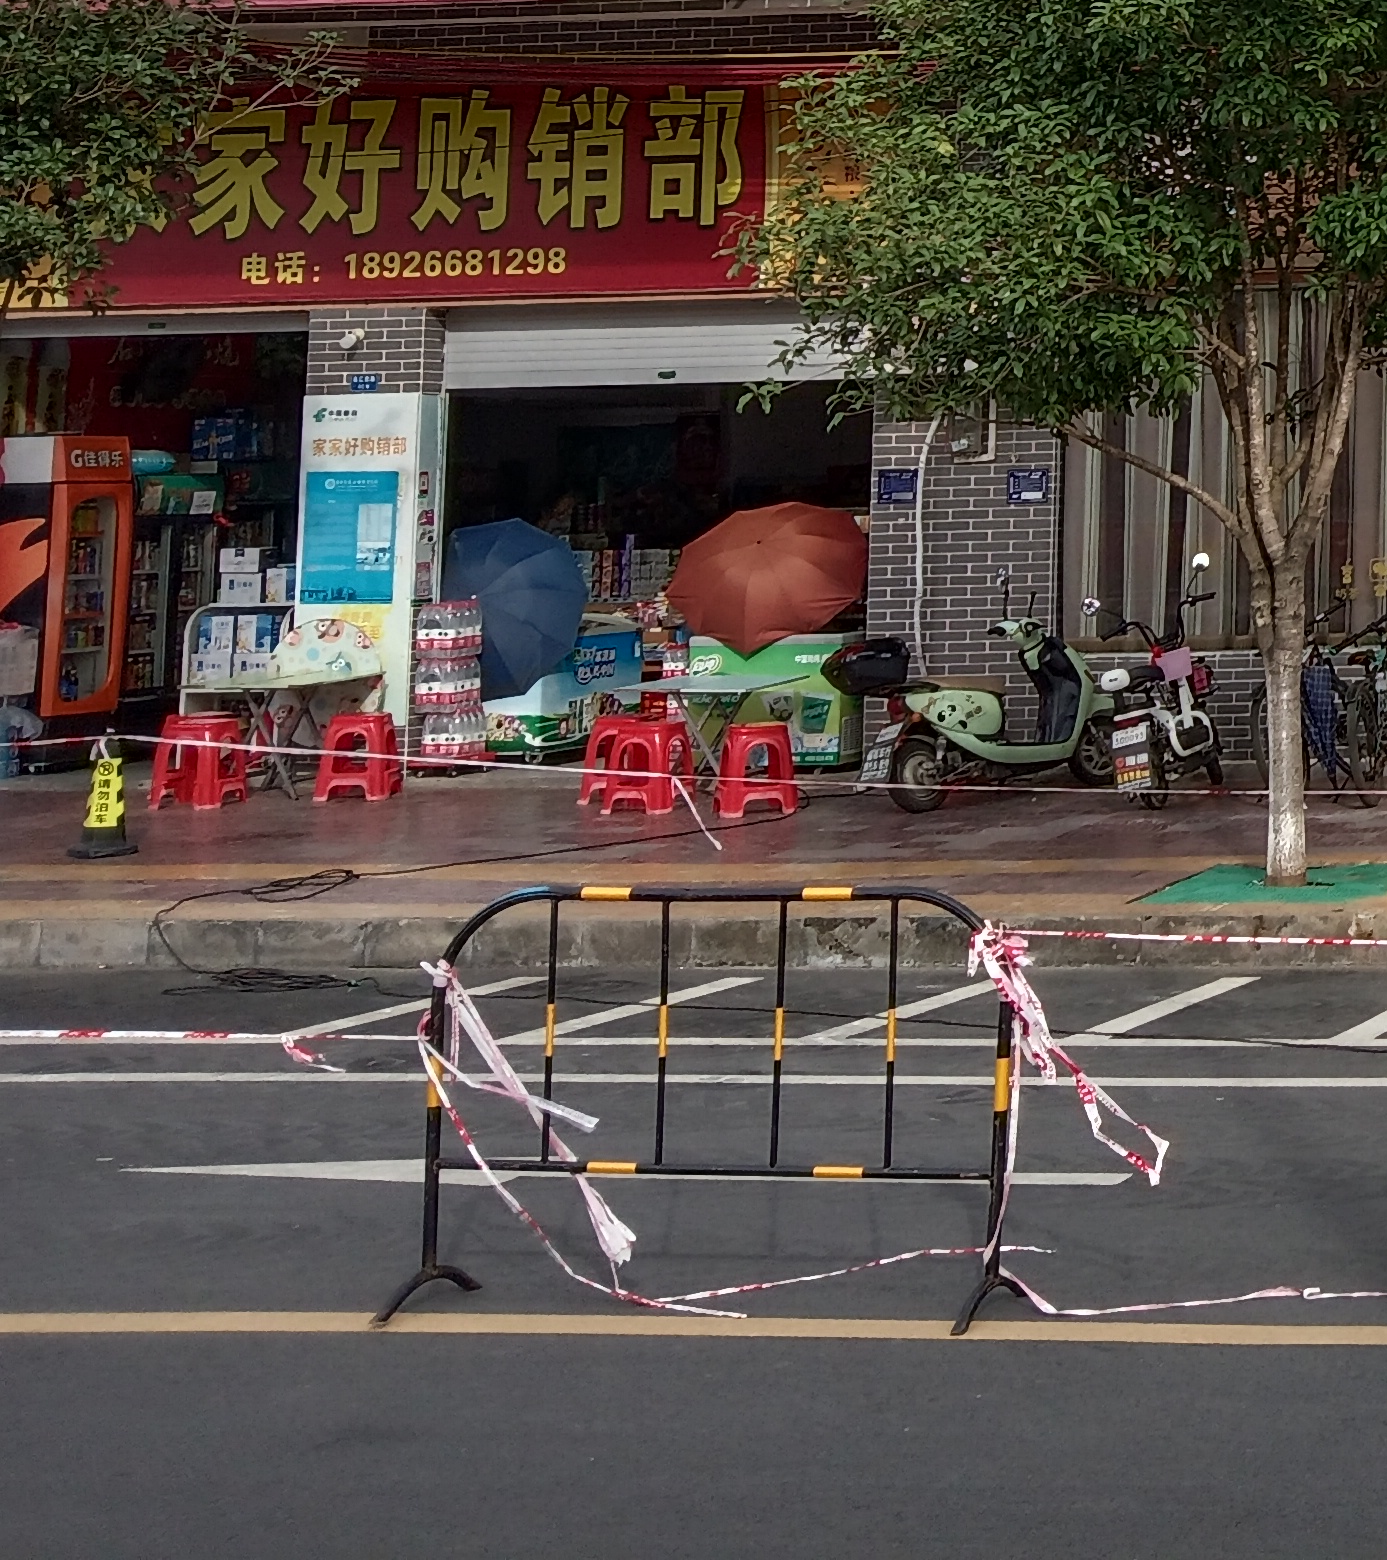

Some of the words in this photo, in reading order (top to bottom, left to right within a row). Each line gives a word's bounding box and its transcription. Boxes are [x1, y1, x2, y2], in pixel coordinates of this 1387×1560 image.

[312, 436, 407, 457] 家家好购销部
[93, 778, 112, 825] 请勿泊车
